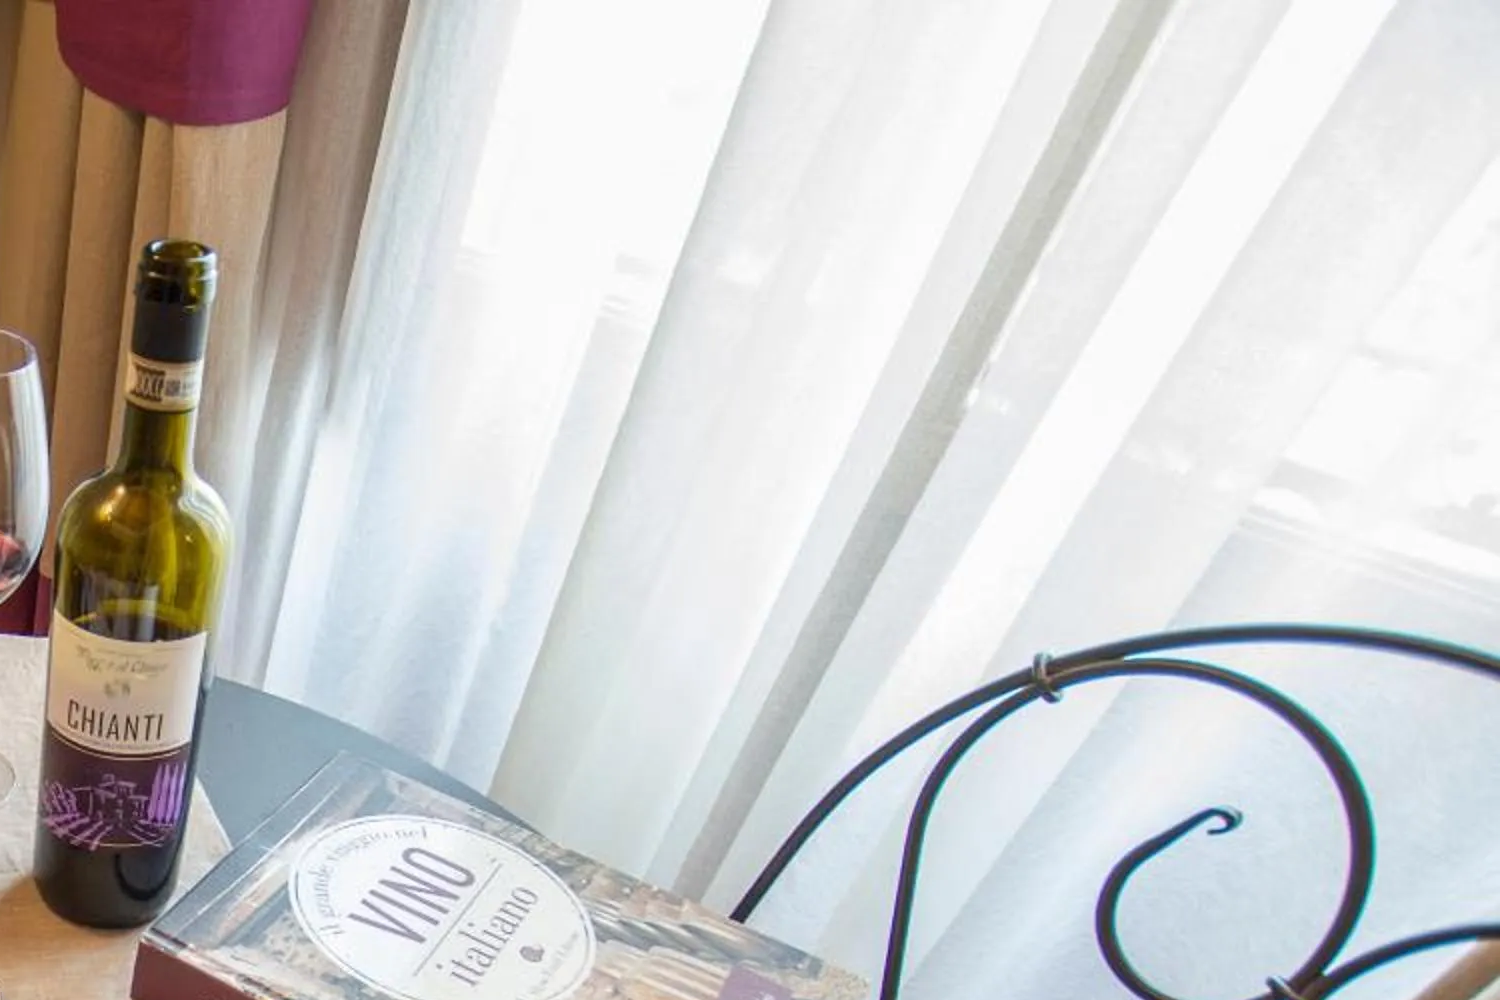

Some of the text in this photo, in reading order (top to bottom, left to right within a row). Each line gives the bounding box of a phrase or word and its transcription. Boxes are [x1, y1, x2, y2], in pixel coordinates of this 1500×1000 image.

[67, 699, 164, 741] CHIANTI
[348, 847, 476, 944] VINO
[436, 886, 540, 988] italiano
